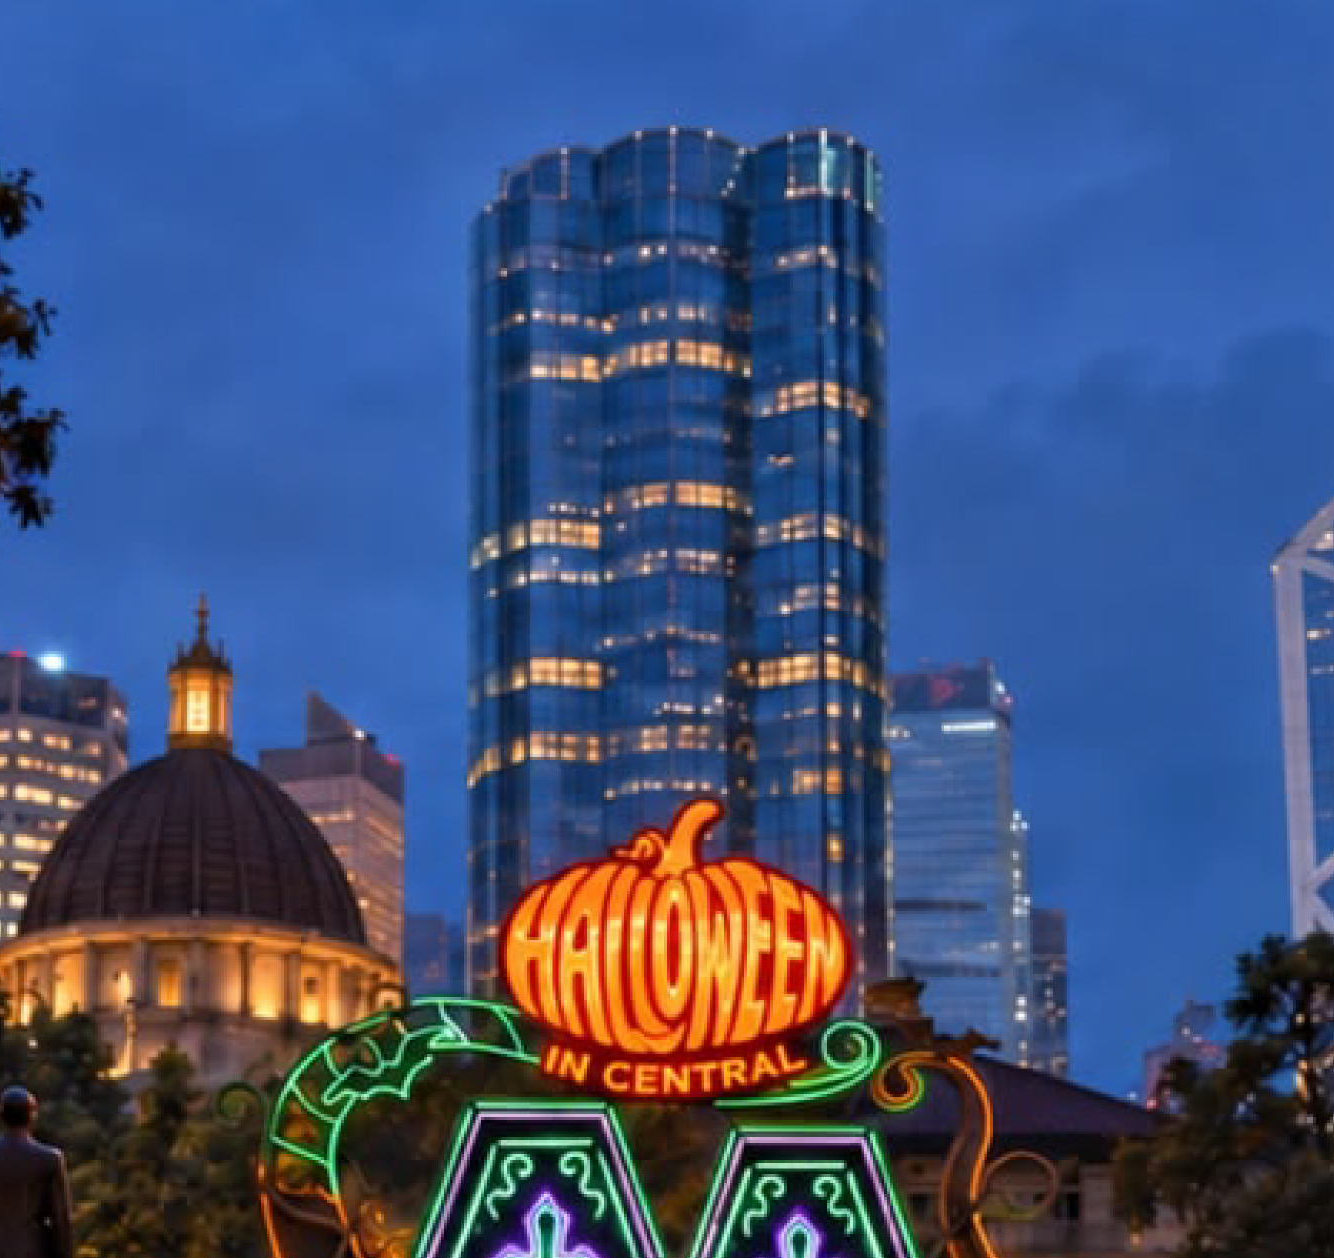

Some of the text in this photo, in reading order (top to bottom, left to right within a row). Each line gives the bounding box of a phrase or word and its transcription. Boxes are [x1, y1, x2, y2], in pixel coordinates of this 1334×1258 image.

[505, 860, 845, 1053] HALLOWEEN
[543, 1044, 807, 1094] IN CENTRAL
